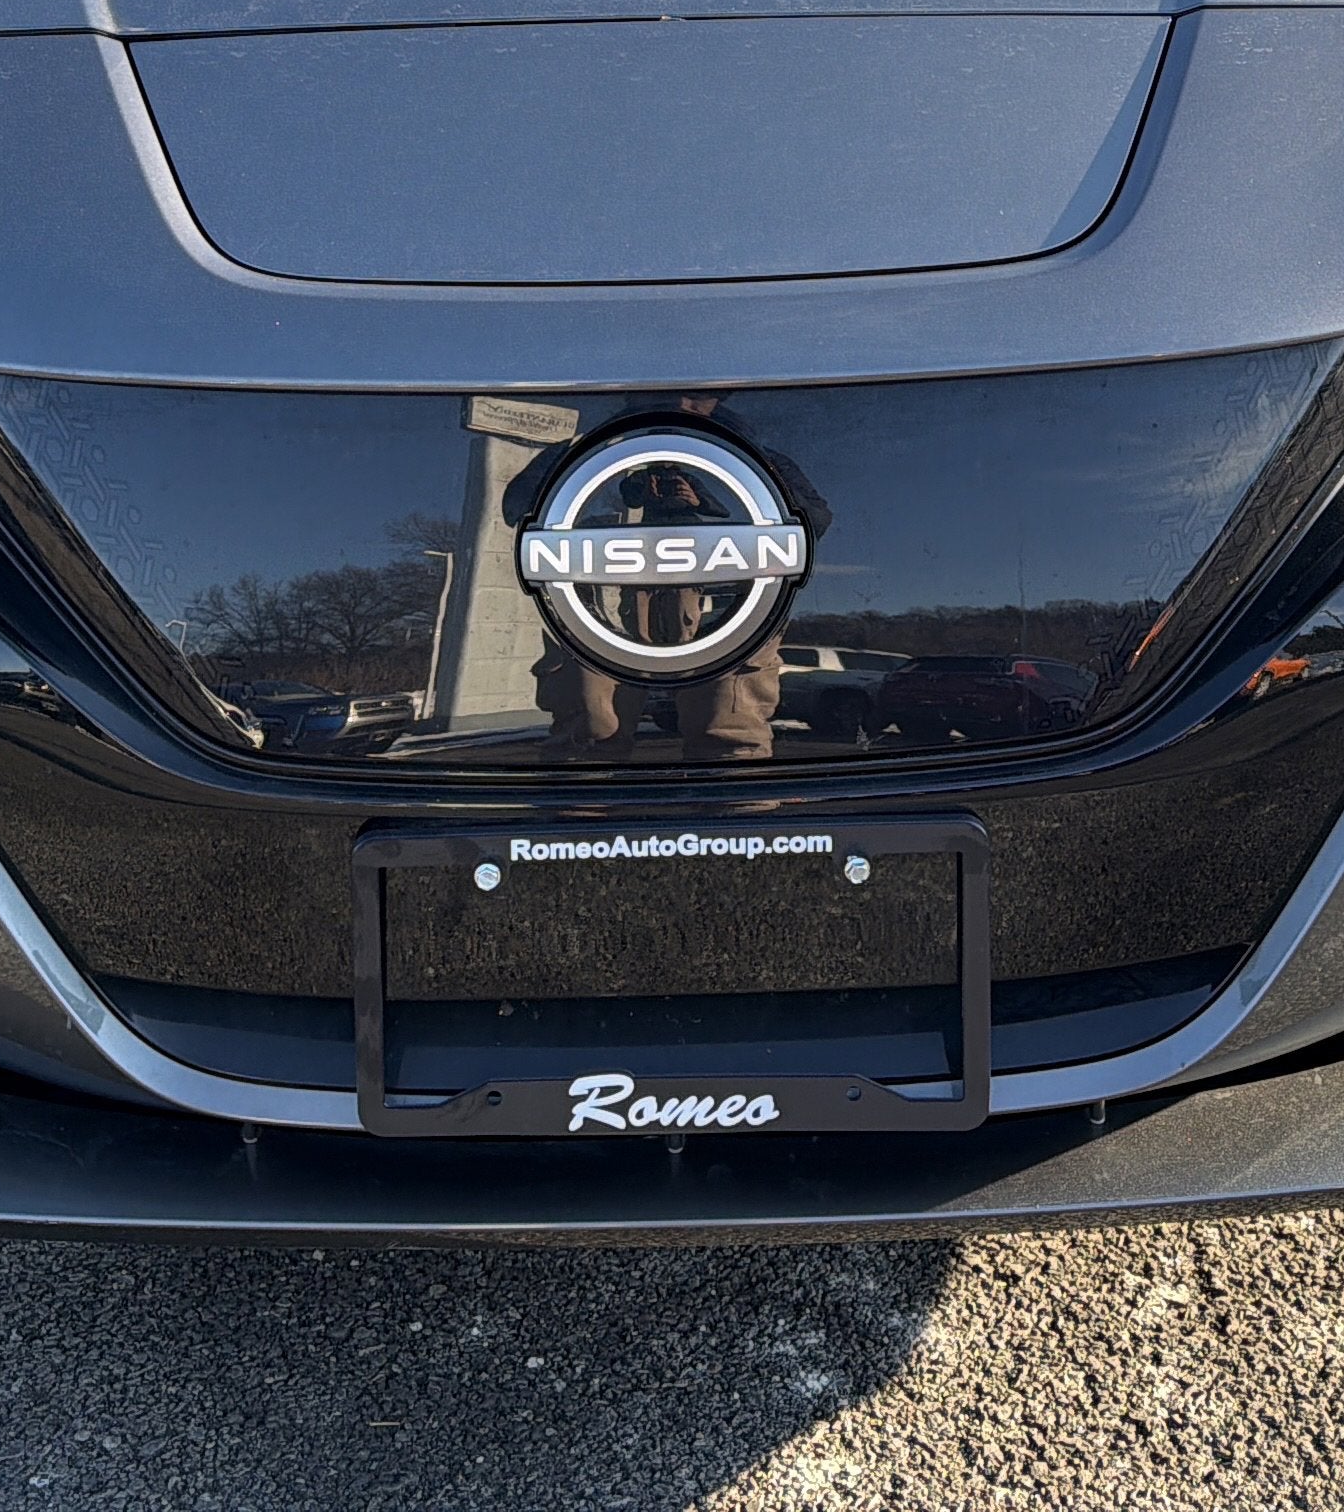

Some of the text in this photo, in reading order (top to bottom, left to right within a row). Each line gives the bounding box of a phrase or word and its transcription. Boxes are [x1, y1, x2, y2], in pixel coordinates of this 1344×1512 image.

[529, 533, 798, 574] NISSAN
[510, 833, 833, 861] RomeoAutoGroup.com
[568, 1073, 780, 1133] Romeo
